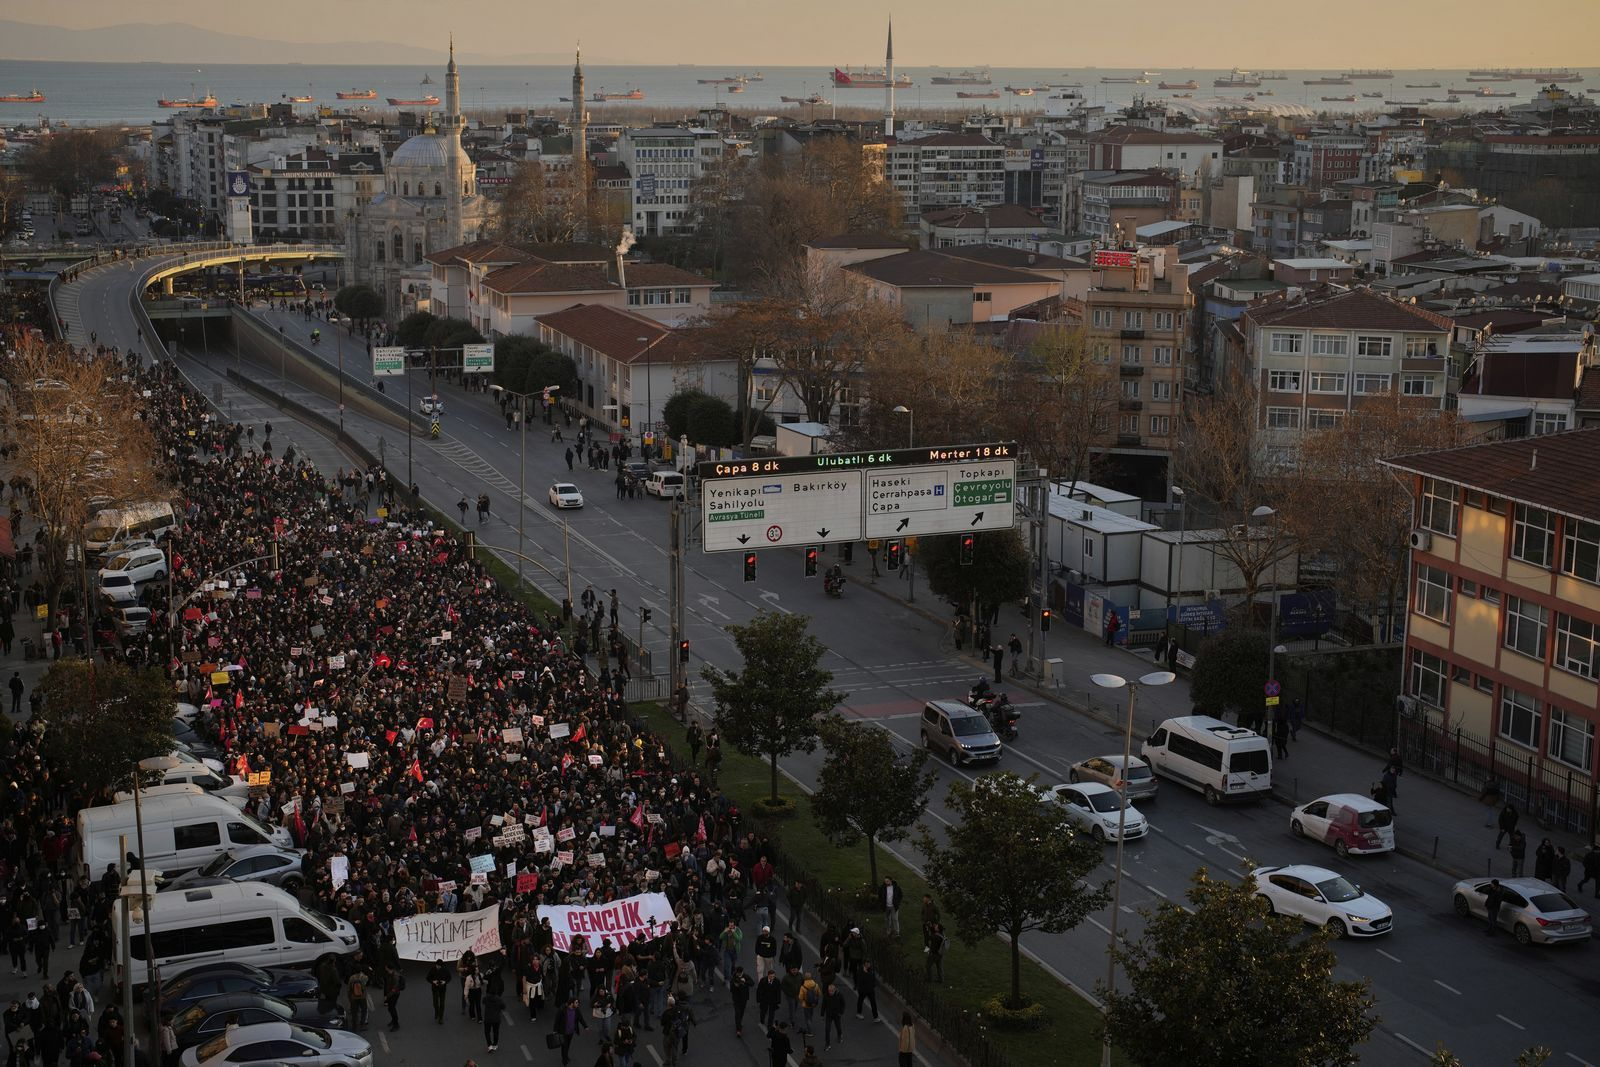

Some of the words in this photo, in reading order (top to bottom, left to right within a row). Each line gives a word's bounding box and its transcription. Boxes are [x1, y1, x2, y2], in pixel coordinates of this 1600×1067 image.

[930, 450, 971, 460] Merter
[976, 447, 991, 457] 18
[995, 446, 1009, 456] dk
[817, 455, 864, 466] Ulubatlı
[868, 455, 875, 463] 6
[878, 454, 892, 463] dk
[716, 463, 747, 475] Çapa
[752, 463, 760, 471] 8
[764, 461, 780, 471] dk
[960, 469, 1005, 479] Topkapı
[793, 481, 847, 492] Bakırköy
[872, 478, 911, 488] Haseki
[954, 481, 1011, 493] Çevreyolu
[710, 487, 761, 498] Yenikapı
[872, 488, 932, 500] Cerrahpaşa
[709, 498, 765, 510] Sahilyolu
[954, 494, 993, 504] Otogar
[872, 502, 900, 512] Çapa
[567, 901, 644, 932] GENÇLİK
[406, 917, 487, 944] HÜKÜMET
[552, 931, 593, 955] BİT
